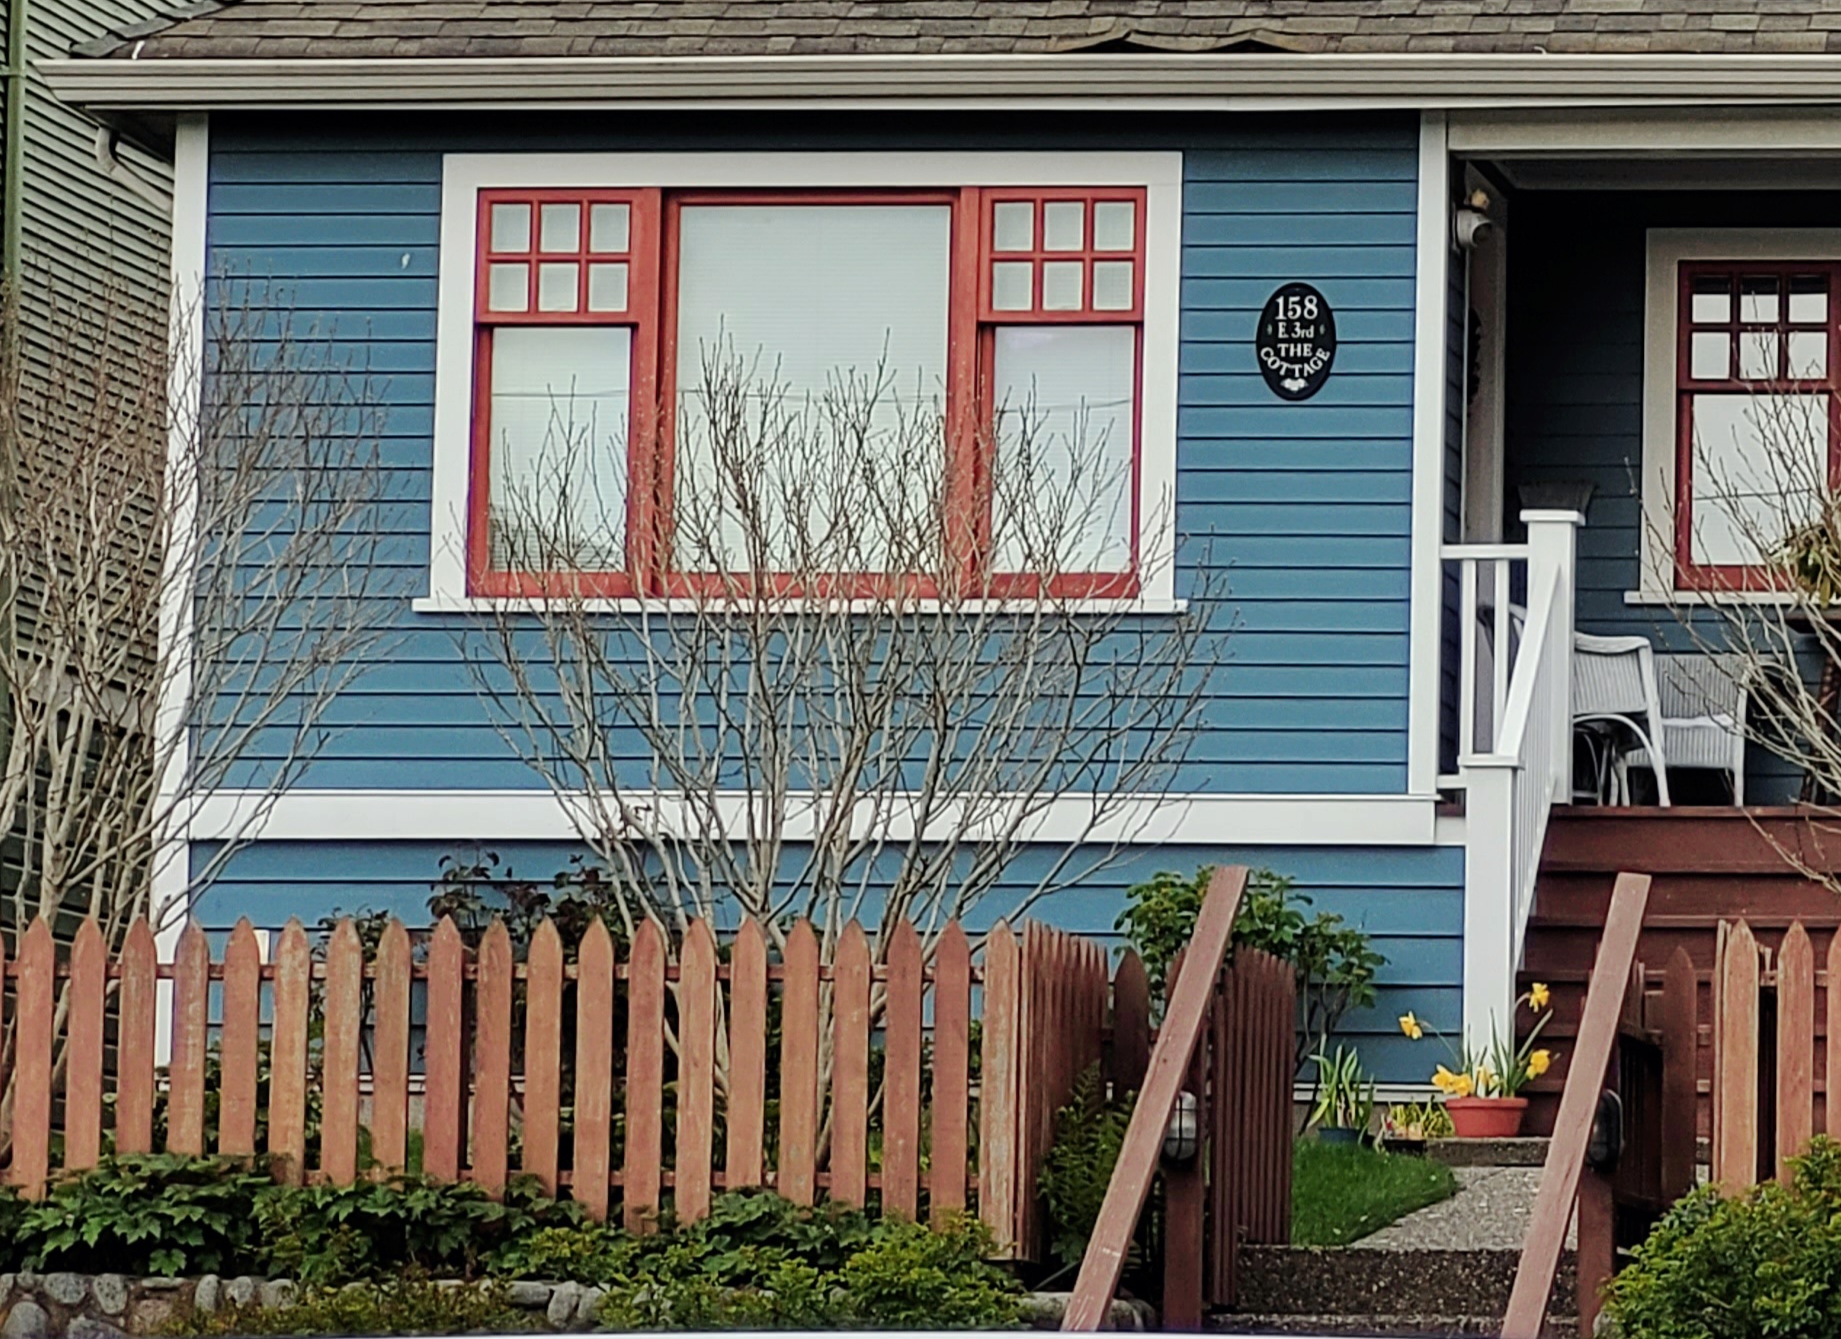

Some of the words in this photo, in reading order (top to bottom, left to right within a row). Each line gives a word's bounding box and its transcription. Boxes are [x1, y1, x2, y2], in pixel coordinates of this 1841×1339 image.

[1275, 295, 1318, 320] 158
[1278, 322, 1289, 338] E
[1291, 322, 1314, 338] 3rd
[1277, 343, 1313, 357] THE
[1260, 347, 1331, 378] COTTAGE
